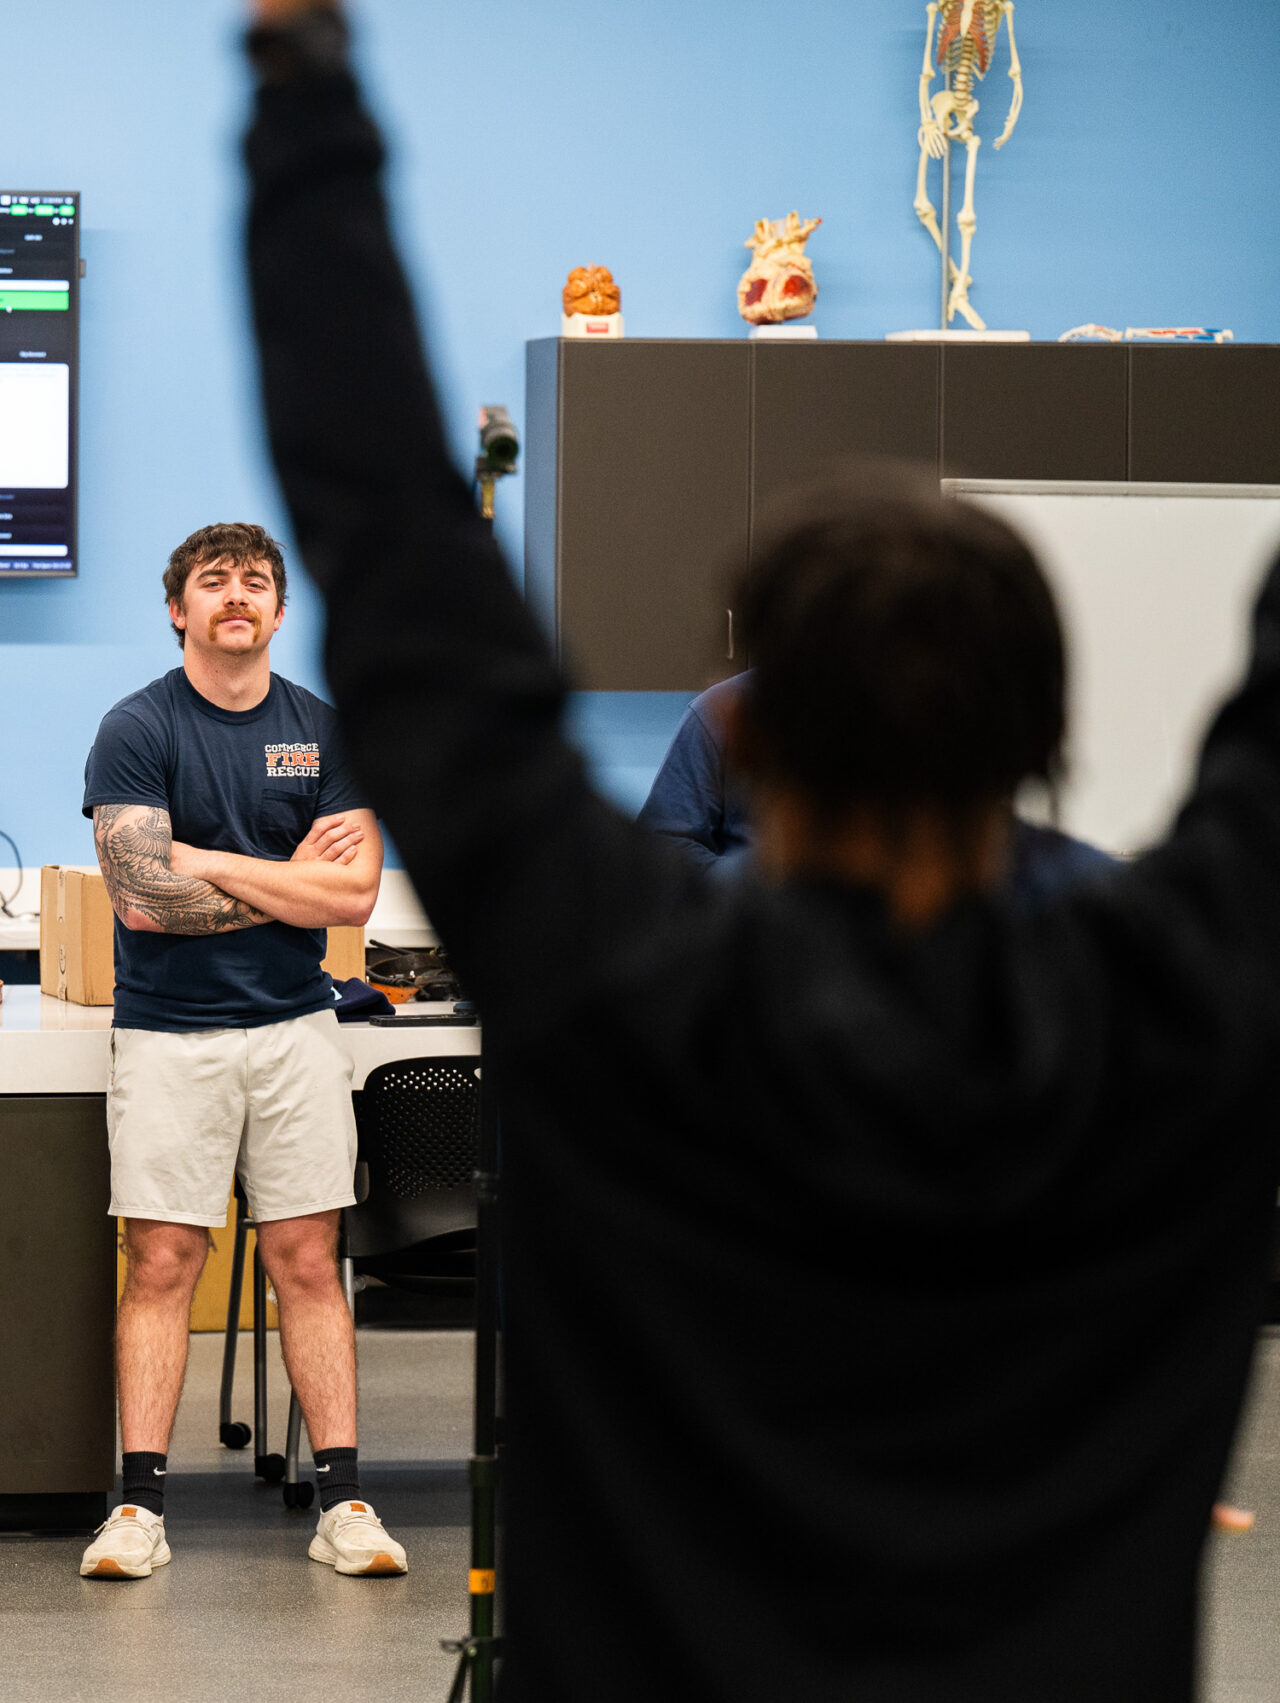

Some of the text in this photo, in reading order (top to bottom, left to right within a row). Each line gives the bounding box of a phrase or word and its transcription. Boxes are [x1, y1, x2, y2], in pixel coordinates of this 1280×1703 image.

[264, 742, 319, 752] COMMERCE
[266, 752, 320, 766] FIRE
[266, 766, 320, 777] RESCUE
